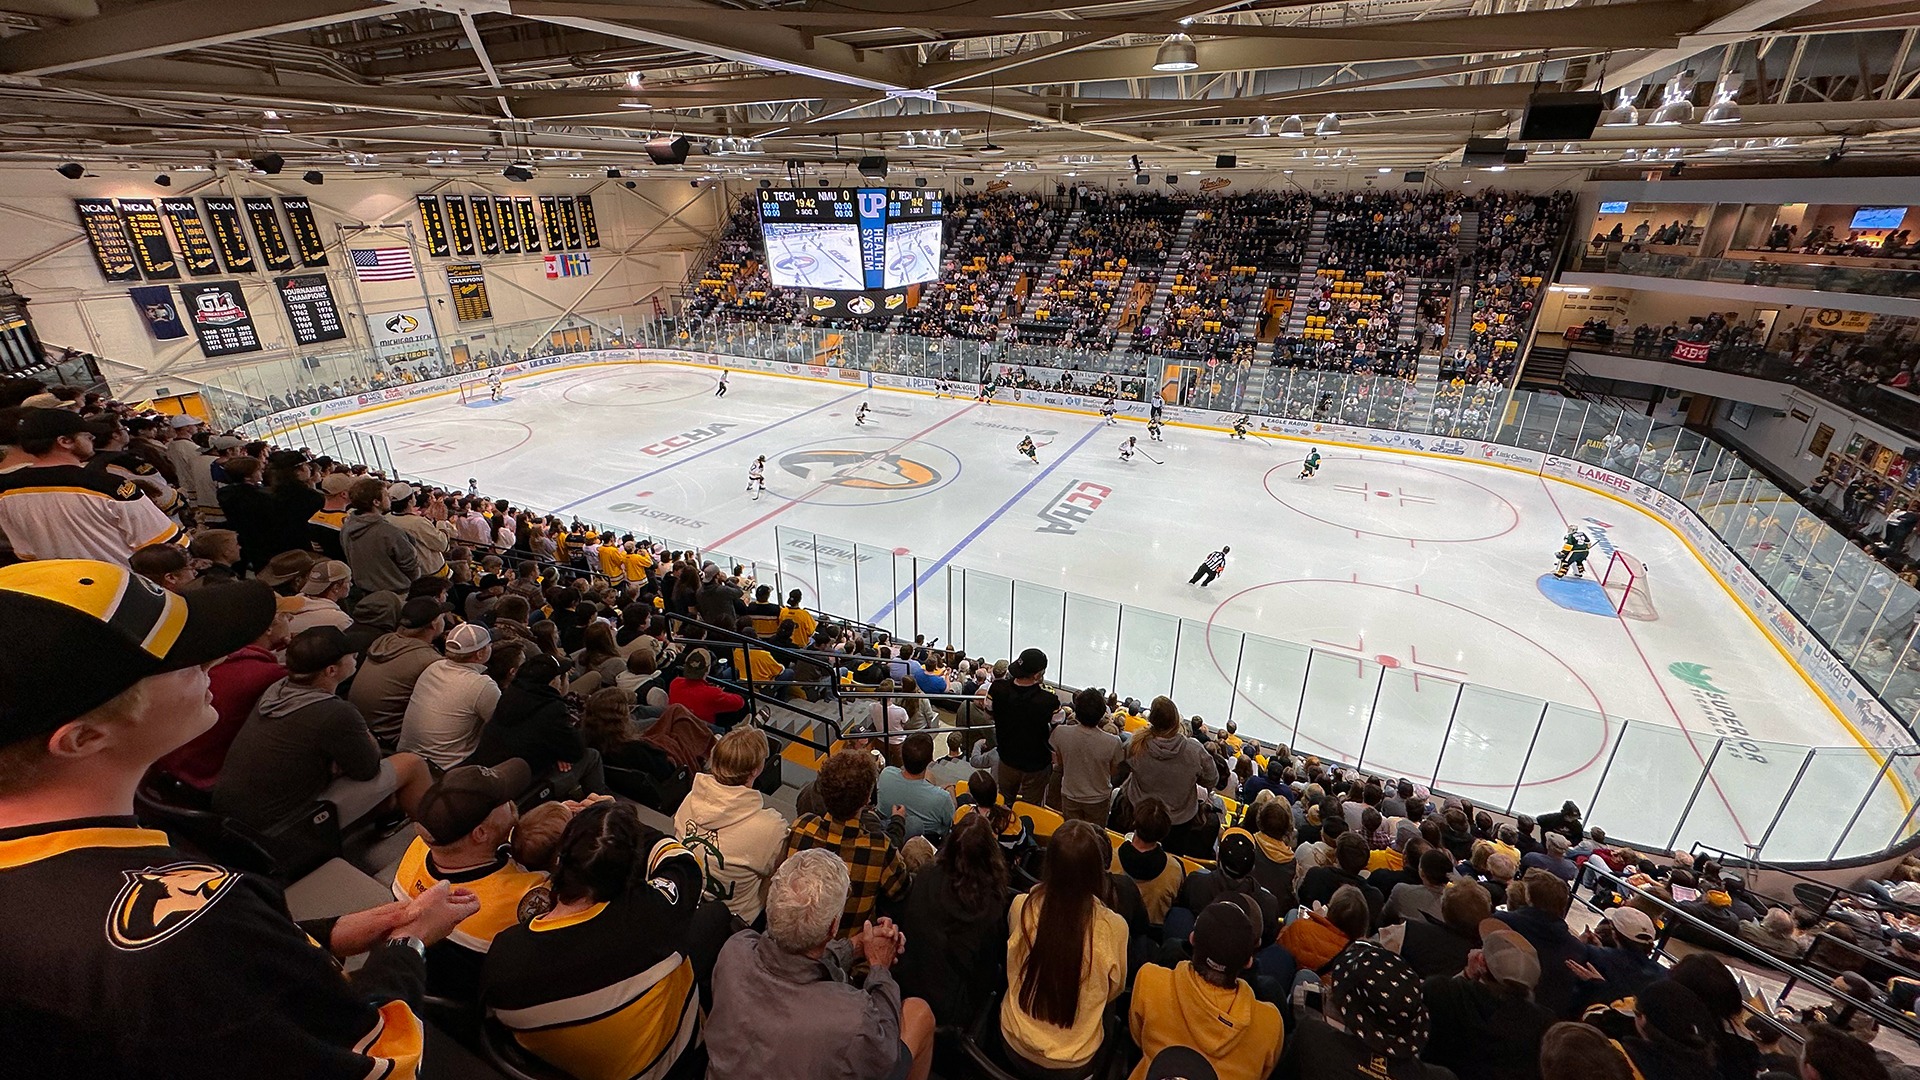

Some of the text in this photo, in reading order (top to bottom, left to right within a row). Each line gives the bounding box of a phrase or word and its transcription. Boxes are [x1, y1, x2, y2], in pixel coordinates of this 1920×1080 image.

[122, 203, 156, 212] NCAA
[165, 203, 195, 211] NCAA
[207, 203, 235, 211] NCAA
[283, 201, 308, 209] NCAA
[762, 190, 769, 201] 0
[773, 191, 796, 201] TECH
[818, 191, 837, 201] NMU
[843, 190, 850, 201] 0
[857, 193, 887, 218] UP
[898, 191, 913, 200] TECH
[80, 204, 114, 213] NCAA
[526, 204, 536, 236] 1971
[230, 217, 246, 251] 1975
[269, 216, 284, 249] 1965
[305, 215, 319, 247] 1962
[419, 202, 436, 254] CHAMPIONS
[431, 204, 443, 239] 1962
[85, 216, 114, 275] TOURNAMENT
[127, 215, 155, 273] TOURNAMENT
[213, 213, 236, 267] CHAMPIONS
[253, 213, 275, 264] CHAMPIONS
[289, 212, 311, 262] CHAMPIONS
[863, 228, 875, 271] SYSTEM
[873, 228, 884, 270] HEALTH
[282, 285, 327, 296] TOURNAMENT
[287, 291, 327, 302] CHAMPIONS
[290, 303, 306, 311] 1960
[292, 309, 308, 317] 1962
[317, 306, 333, 314] 1976
[323, 324, 339, 332] 2018
[531, 357, 561, 368] TERVO
[449, 372, 480, 382] COUNTRY
[325, 399, 353, 409] ASPIRUS
[640, 422, 738, 456] CCHA
[1496, 450, 1510, 459] Little
[1510, 453, 1533, 463] Caesars
[1577, 466, 1632, 492] LAMERS
[635, 507, 710, 530] ASPIRUS
[1034, 480, 1113, 535] CCHA
[787, 538, 873, 563] KEWEENAW
[1706, 691, 1769, 764] SUPERIOR
